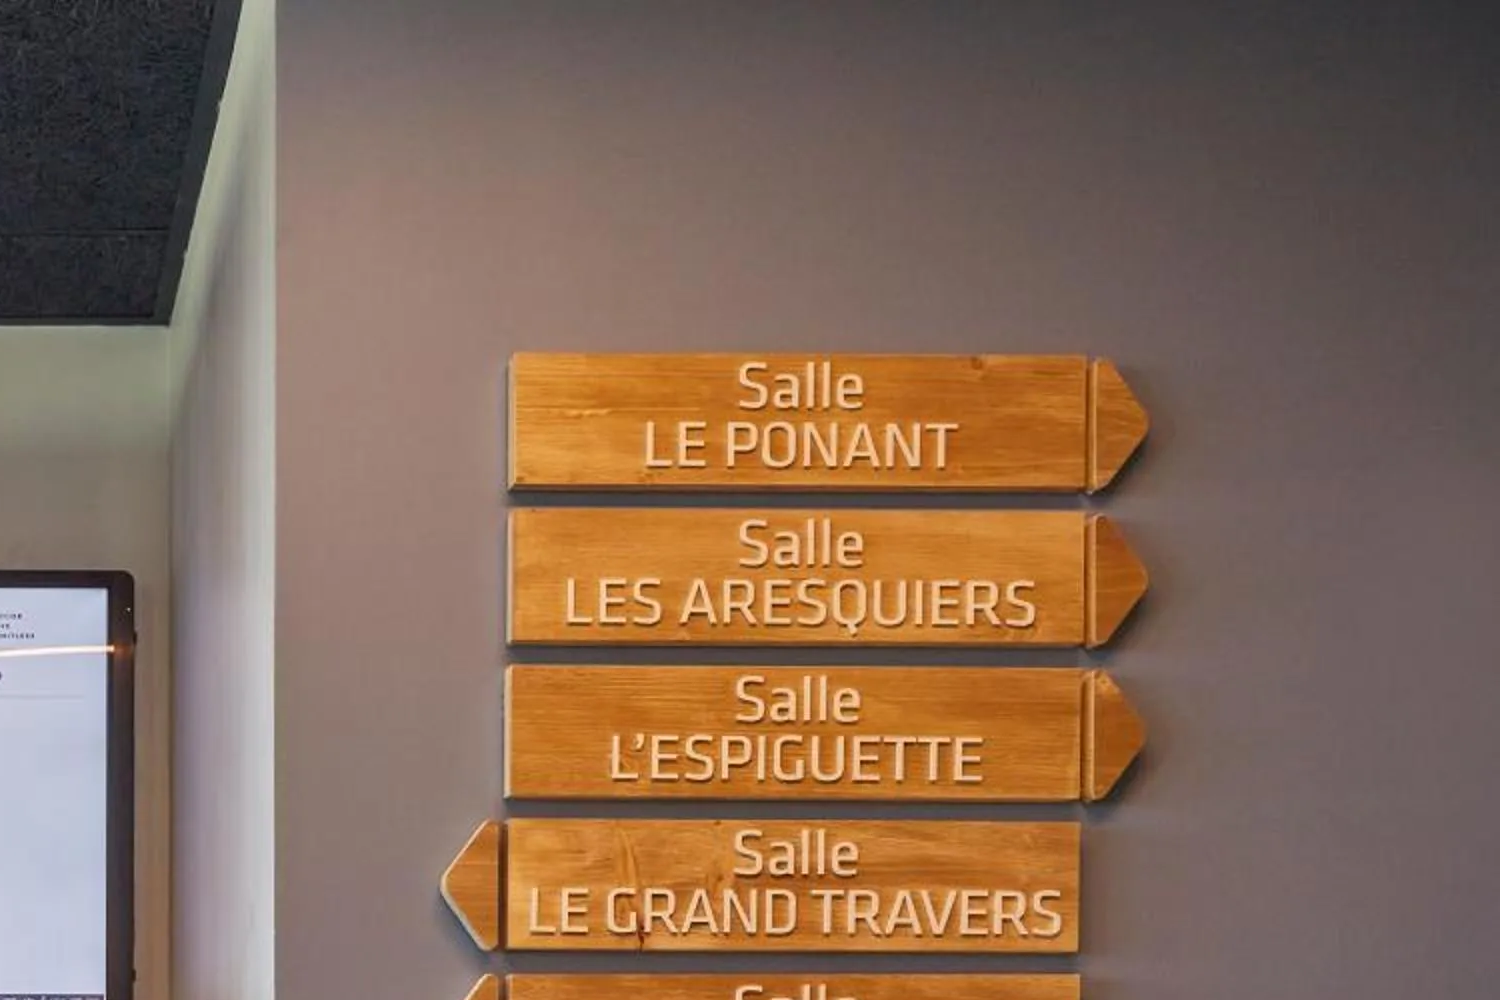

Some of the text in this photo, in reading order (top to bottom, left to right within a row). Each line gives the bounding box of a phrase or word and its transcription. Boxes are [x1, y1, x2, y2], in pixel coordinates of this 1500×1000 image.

[739, 362, 863, 409] Salle
[645, 421, 958, 467] LE PONANT
[739, 518, 863, 566] Salle
[566, 577, 1035, 634] LES ARESQUIERS
[736, 675, 861, 722] Salle
[610, 734, 982, 781] L'ESPIGUETTE
[733, 829, 858, 875] Salle
[527, 887, 1061, 935] LE GRAND TRAVERS
